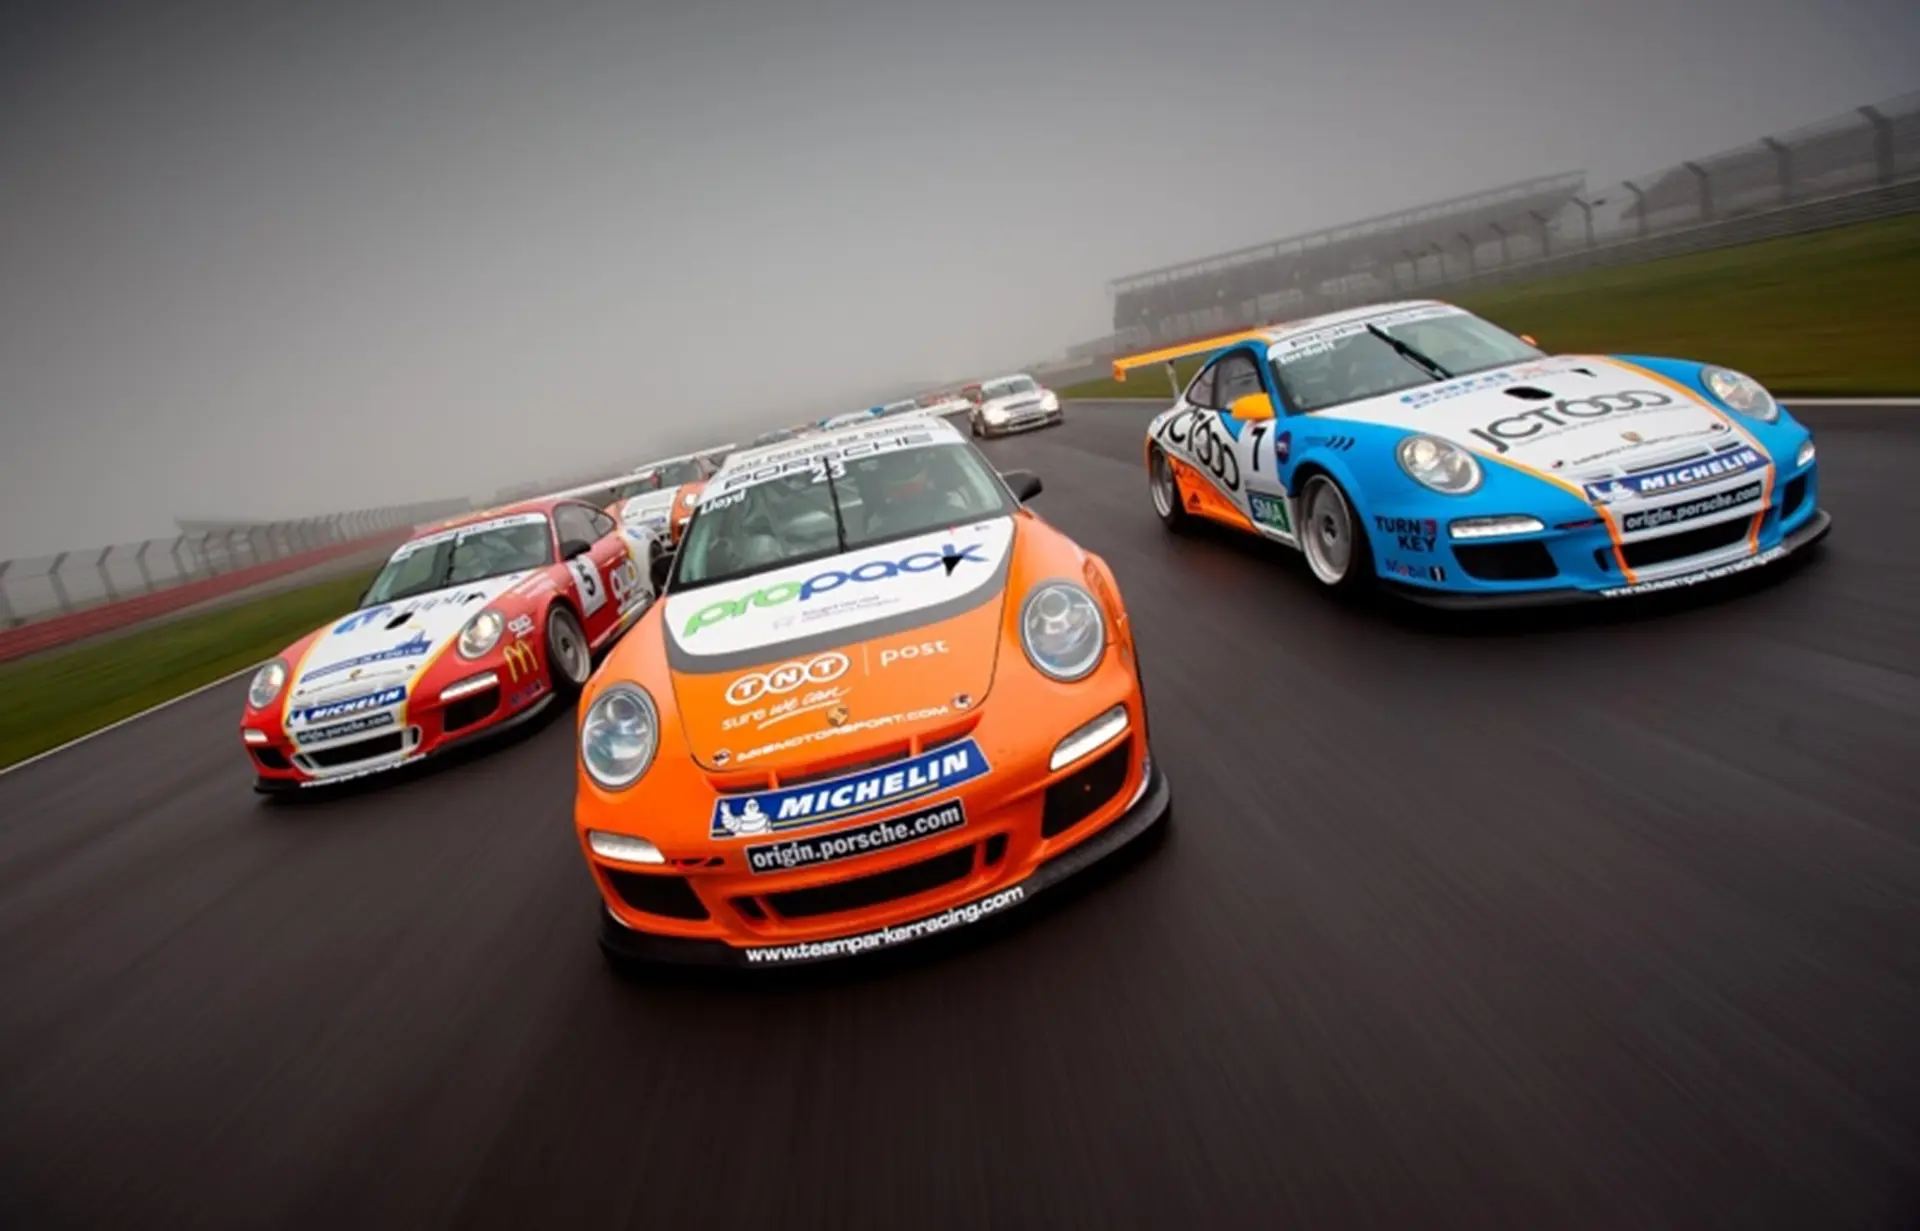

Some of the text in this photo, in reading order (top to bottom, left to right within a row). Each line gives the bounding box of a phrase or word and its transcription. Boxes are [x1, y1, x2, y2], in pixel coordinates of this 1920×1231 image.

[724, 432, 934, 490] PORSCHE
[1251, 427, 1268, 471] 7
[1641, 447, 1757, 491] MICHELIN
[811, 463, 847, 484] 23
[700, 488, 747, 516] Lloyd
[1253, 498, 1284, 528] SMA
[1626, 486, 1762, 529] origin.porsche.com
[1398, 535, 1437, 552] KEY
[578, 566, 597, 597] 5
[683, 542, 990, 638] propack
[731, 640, 949, 702] TNT post
[311, 689, 400, 720] MICHELIN
[721, 708, 766, 731] sure
[777, 749, 969, 820] MICHELIN
[753, 804, 961, 870] origin.porsche.com
[745, 884, 1025, 963] www.teamparkerracing.com
